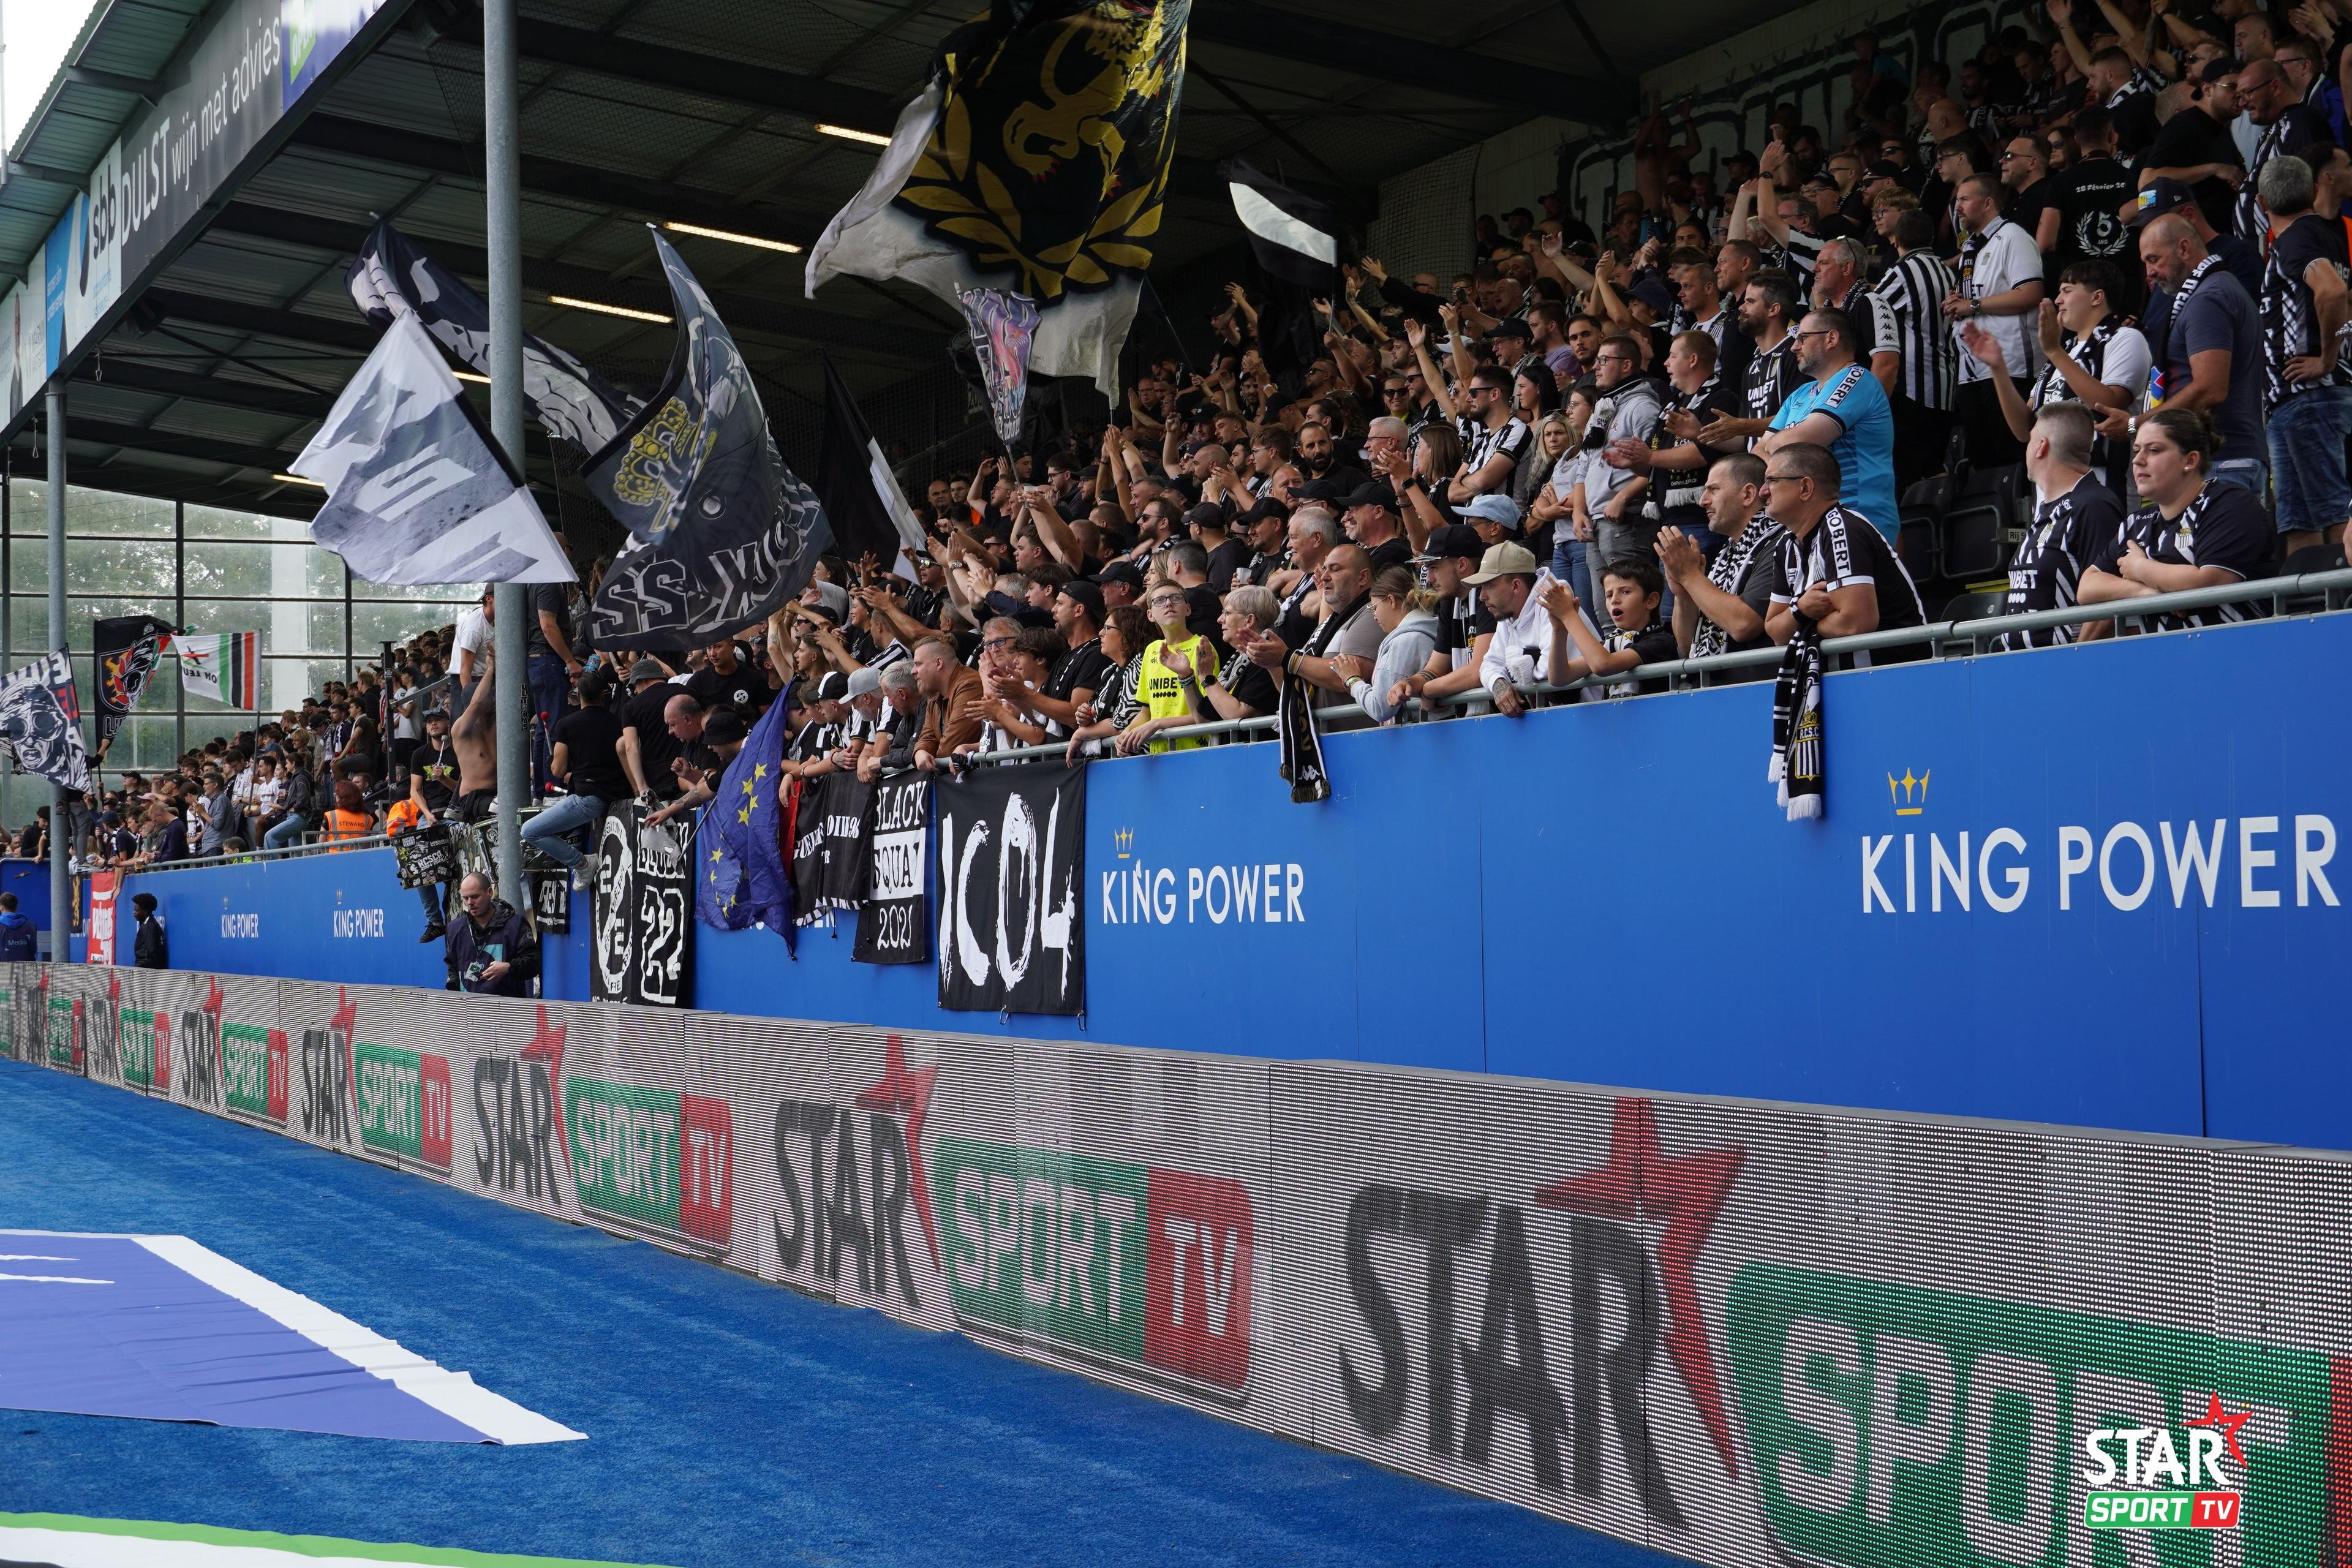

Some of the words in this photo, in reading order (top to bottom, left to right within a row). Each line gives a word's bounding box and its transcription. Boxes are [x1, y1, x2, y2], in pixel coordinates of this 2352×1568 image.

[123, 116, 170, 246] DULST
[172, 111, 197, 191] wijn
[202, 72, 227, 149] met
[232, 17, 280, 114] advies
[93, 164, 116, 260] sbb
[2097, 211, 2112, 237] 5
[1747, 379, 1776, 401] UNIET
[1827, 510, 1850, 571] GOBERT
[2010, 532, 2019, 541] Rij
[1149, 677, 1183, 690] UNIBE
[1102, 868, 1177, 925] KING
[1189, 863, 1305, 924] POWER
[1862, 827, 2030, 913] KING
[2059, 814, 2341, 911] POWER
[221, 914, 236, 938] KING
[237, 913, 258, 938] POWER
[334, 909, 353, 938] KING
[355, 908, 384, 938] POWER
[182, 1008, 219, 1107] STAR
[225, 1036, 268, 1101] SPORT
[271, 1048, 287, 1102] TV
[303, 1026, 353, 1145] STAR
[360, 1060, 420, 1140] SPORT
[425, 1079, 448, 1141] TV
[474, 1054, 562, 1206] STAR
[576, 1098, 675, 1205] SPORT
[689, 1128, 726, 1209] TV
[774, 1102, 921, 1310] STAR
[952, 1166, 1137, 1323] SPORT
[1164, 1216, 1239, 1338] TV
[1340, 1184, 1689, 1532] STAR
